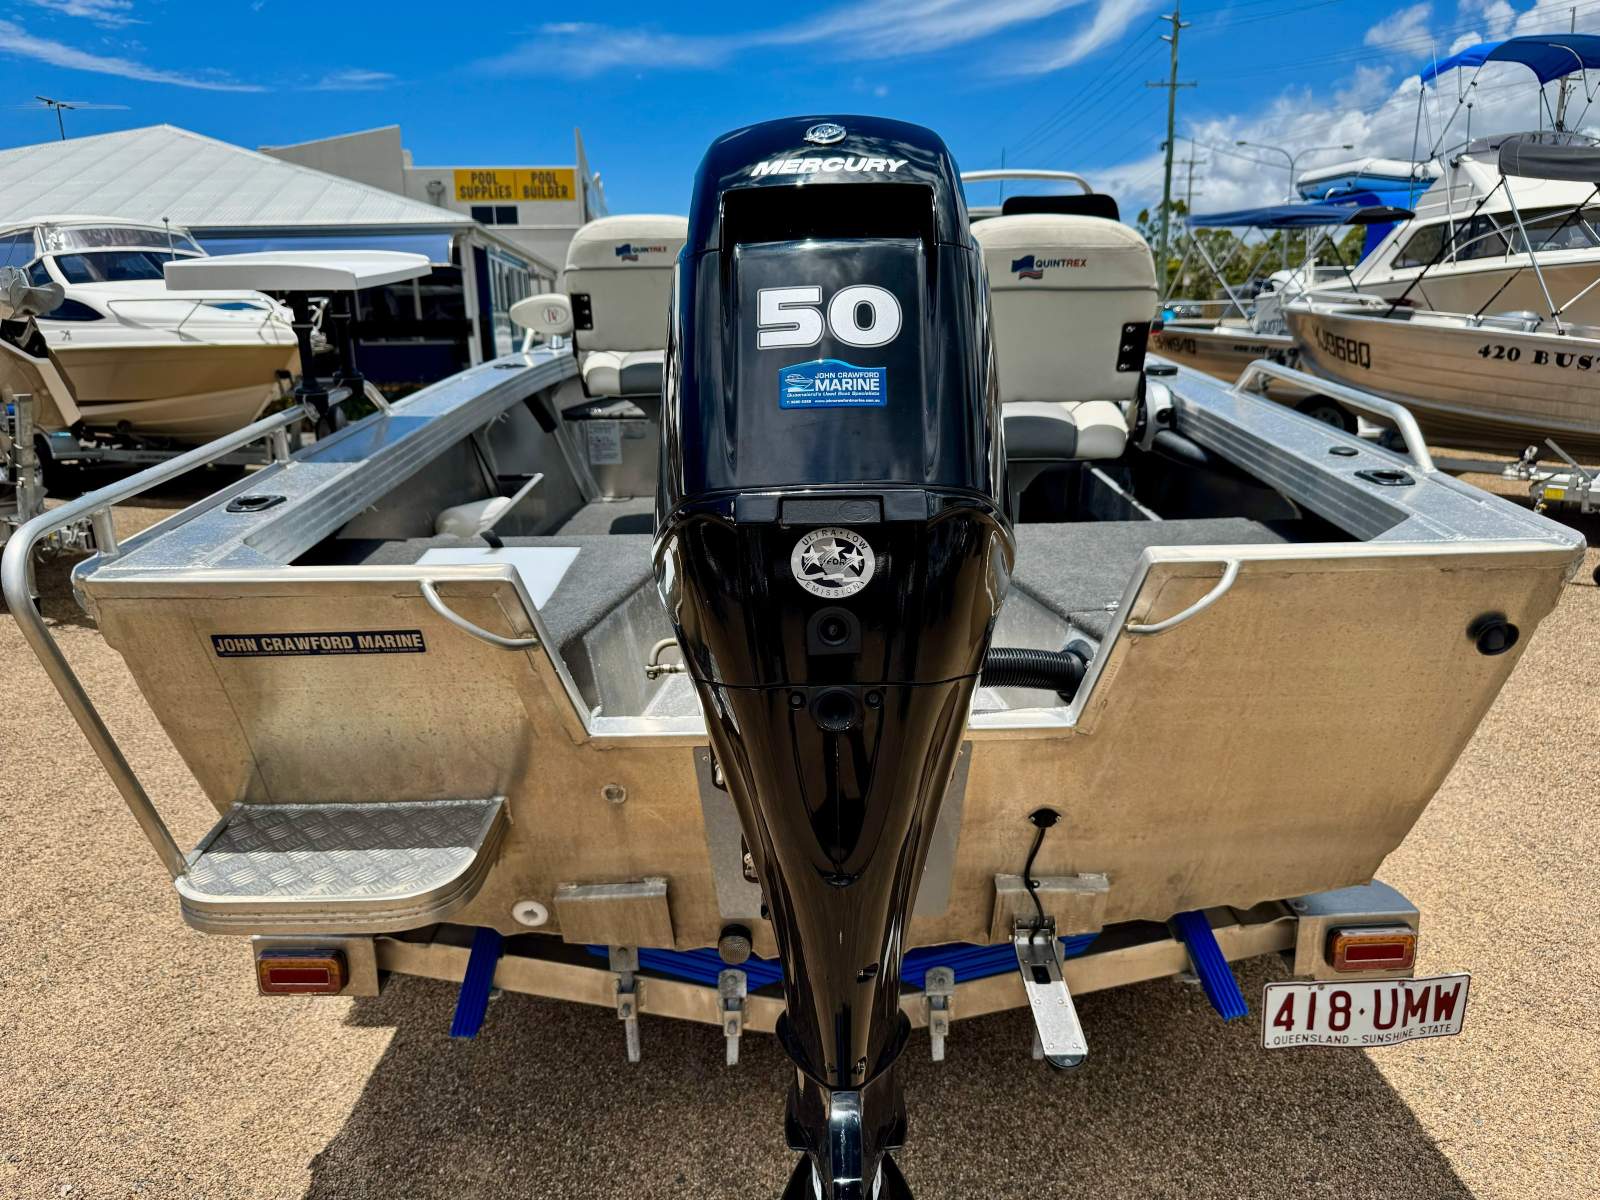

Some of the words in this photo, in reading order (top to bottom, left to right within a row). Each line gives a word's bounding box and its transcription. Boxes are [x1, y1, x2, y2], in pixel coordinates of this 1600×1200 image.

[751, 157, 909, 177] MERCURY
[471, 172, 497, 185] POOL
[531, 172, 557, 185] POOL
[460, 185, 512, 199] SUPPLIES
[523, 185, 568, 199] BUILDER
[1035, 259, 1087, 268] QUINTREX
[757, 284, 903, 350] 50
[1478, 344, 1521, 362] 420
[837, 371, 880, 379] CRAWFORD
[815, 379, 880, 392] MARINE
[801, 529, 837, 547] ULTRA
[846, 533, 868, 551] LOW
[216, 638, 258, 652] JOHN
[261, 635, 354, 650] CRAWFORD
[357, 633, 424, 649] MARINE
[1273, 1033, 1349, 1045] QUEENSLAND
[1361, 1027, 1414, 1044] SUNSHINE
[1419, 1023, 1451, 1034] STATE
